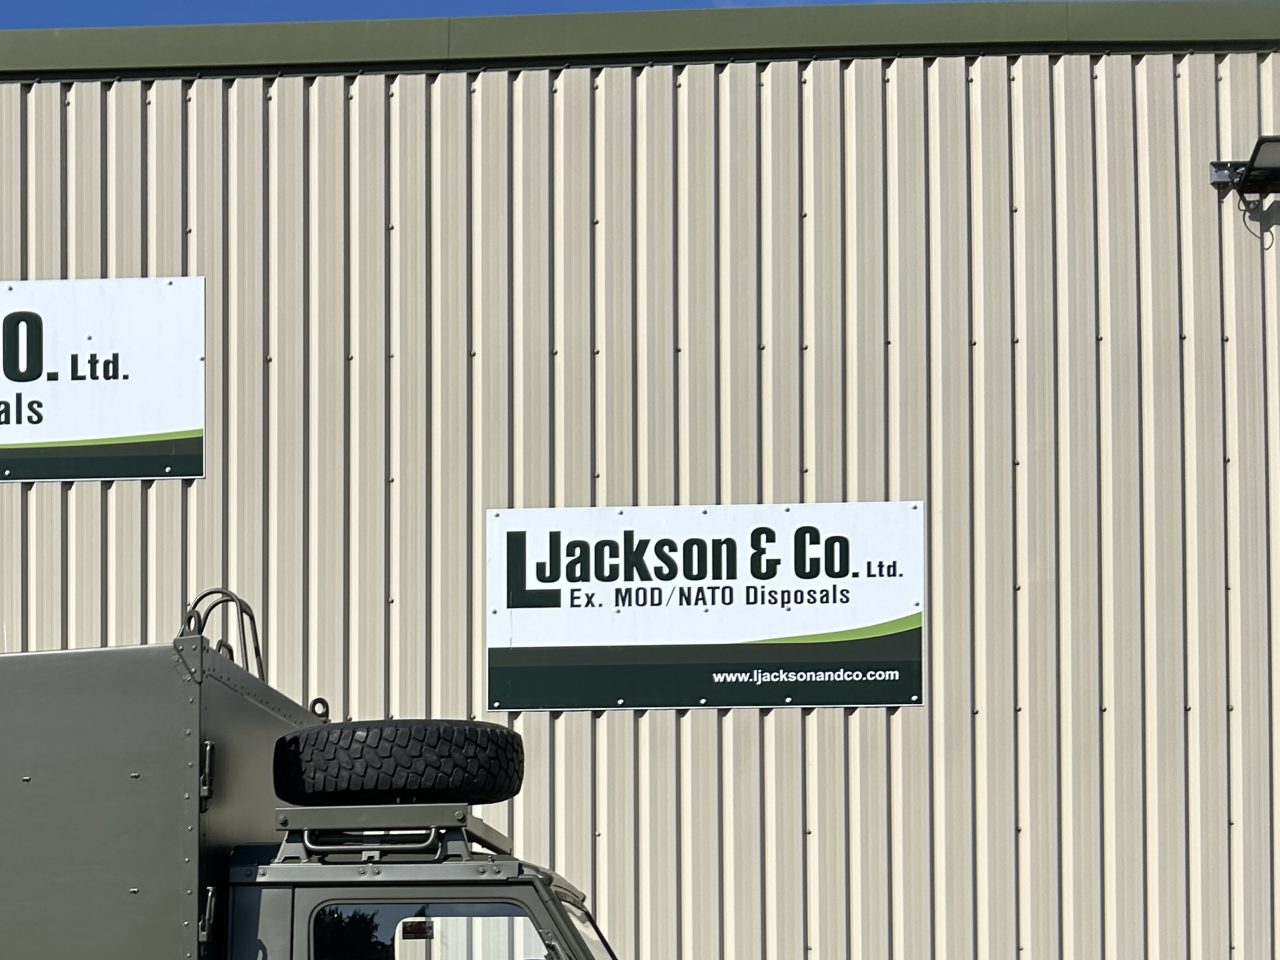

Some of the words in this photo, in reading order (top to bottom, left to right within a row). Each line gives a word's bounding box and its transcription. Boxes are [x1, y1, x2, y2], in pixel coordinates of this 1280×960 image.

[70, 352, 130, 381] Ltd.
[749, 527, 782, 581] &
[793, 526, 860, 580] Co.
[866, 560, 904, 578] Ltd.
[569, 588, 603, 608] Ex.
[614, 586, 734, 608] MOD/NATO
[745, 584, 850, 609] Disposals
[712, 669, 900, 686] www.ljacksonandco.com
